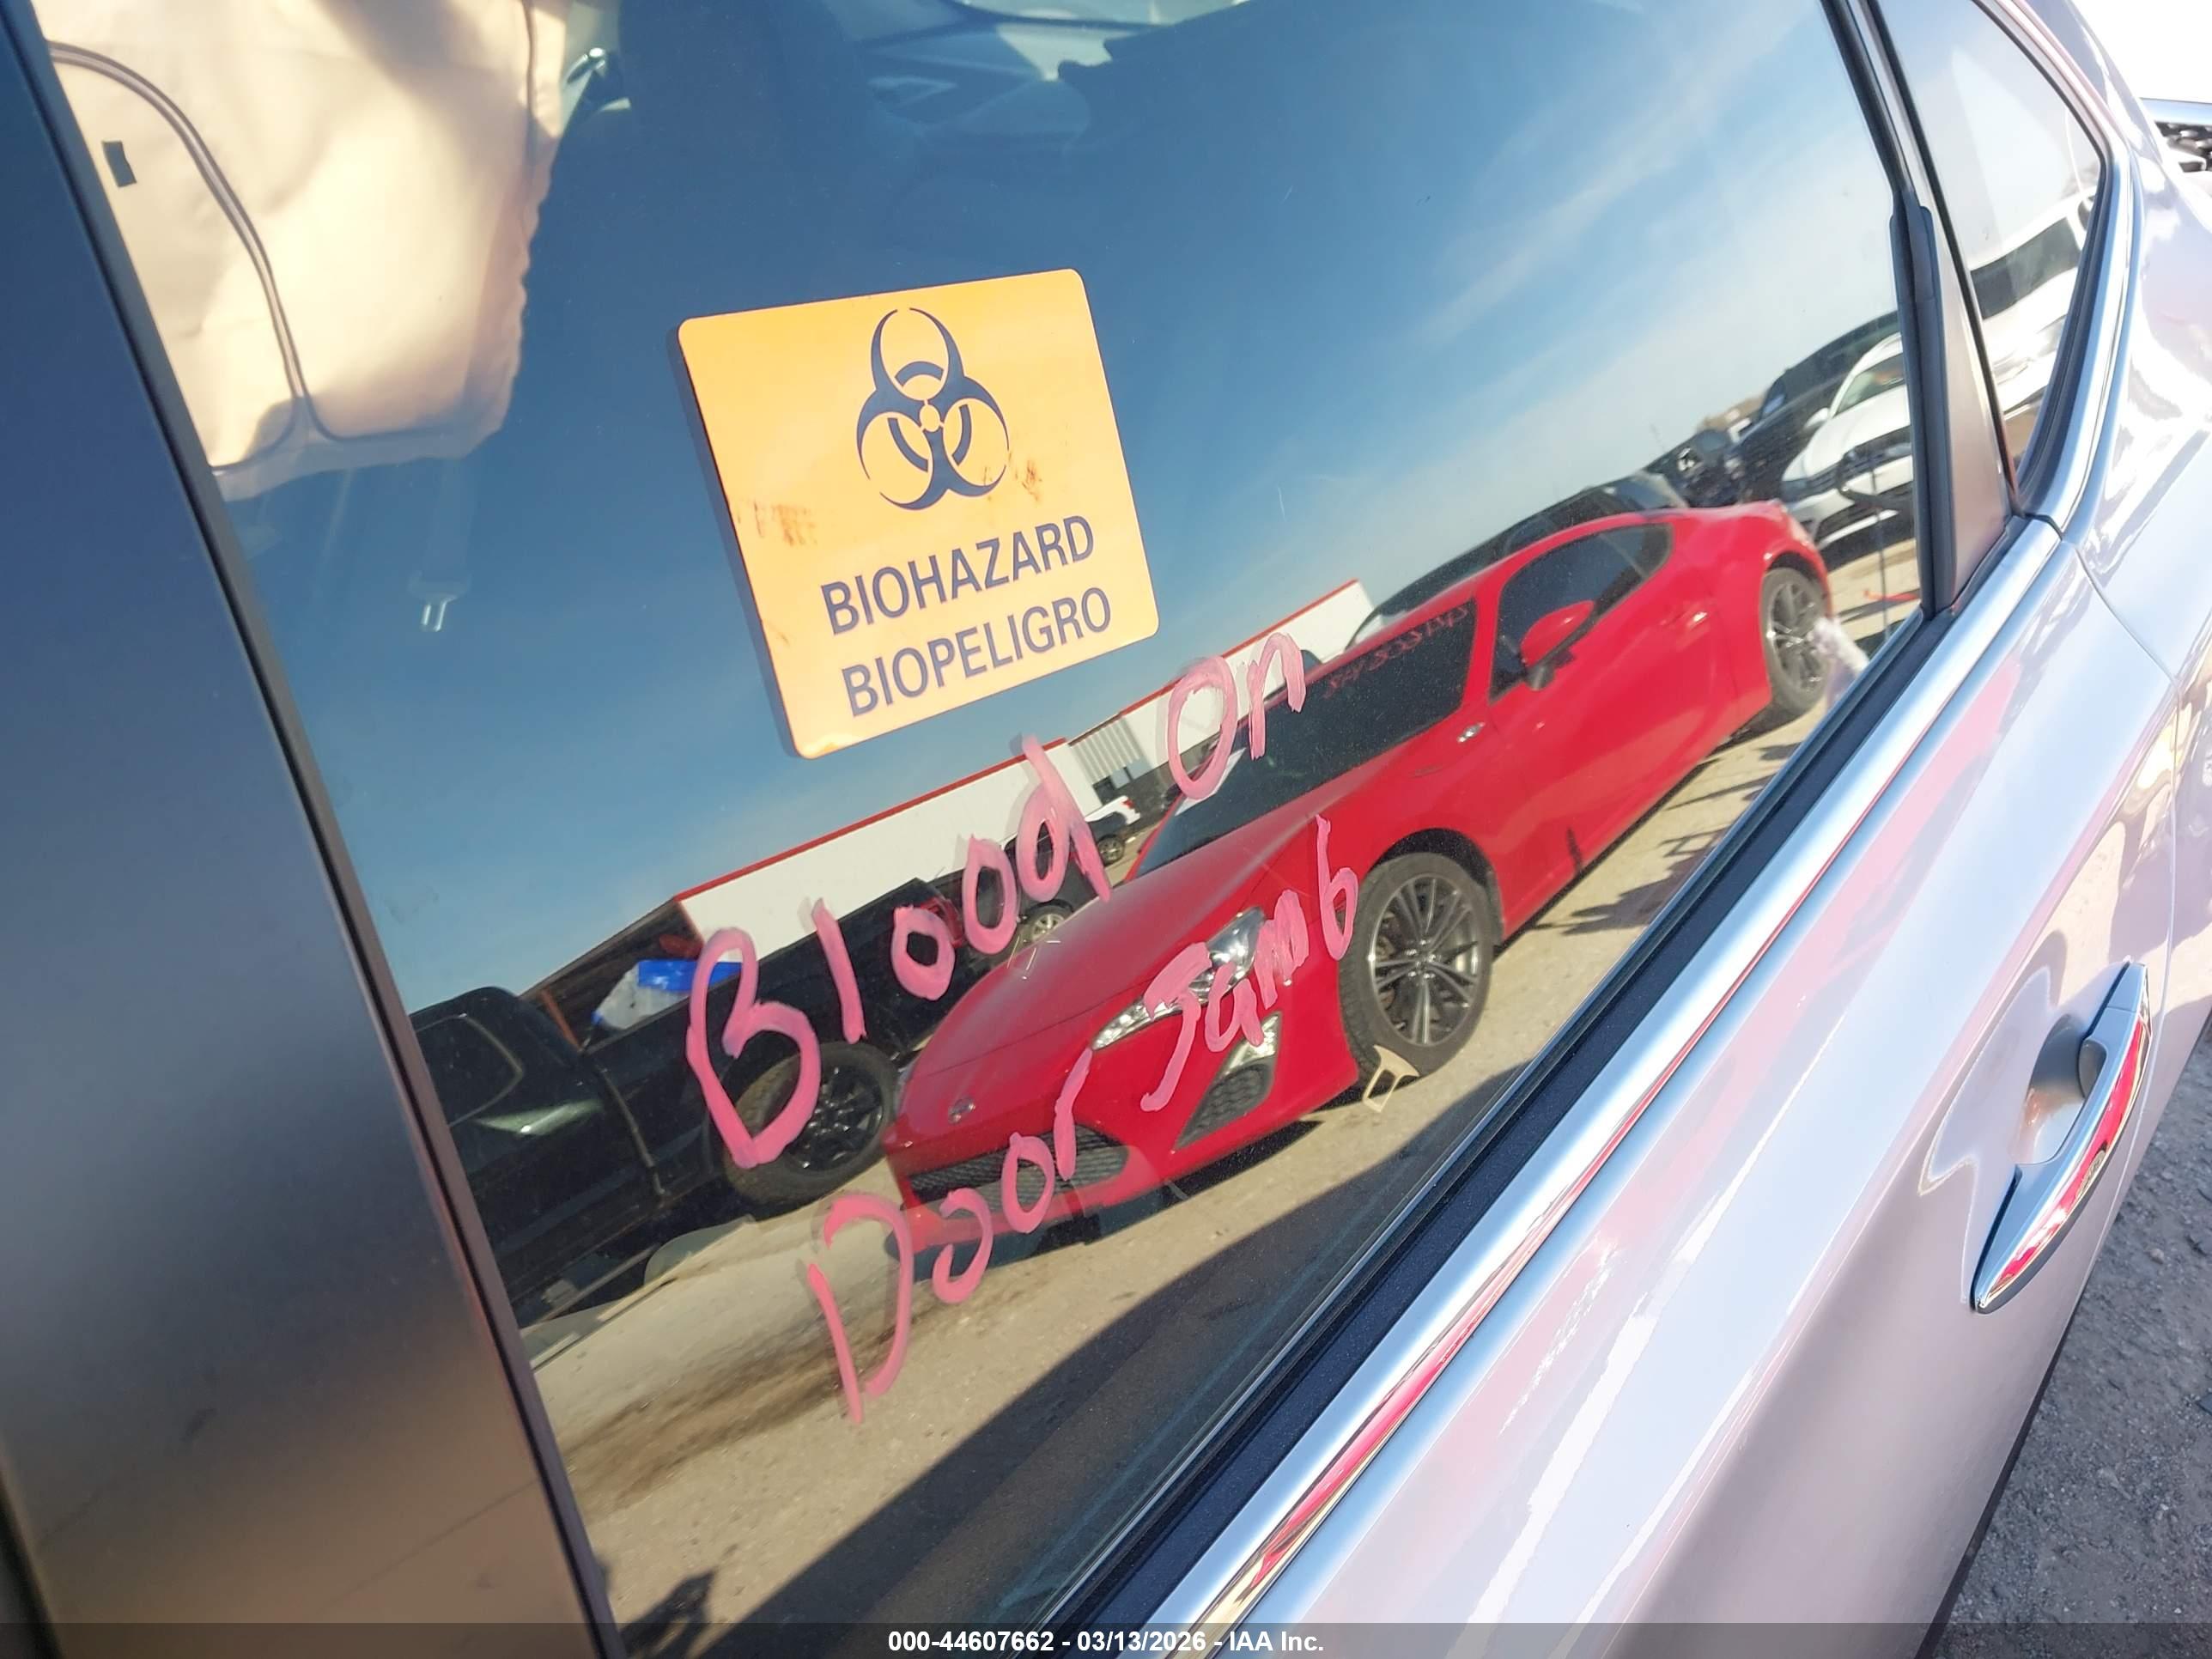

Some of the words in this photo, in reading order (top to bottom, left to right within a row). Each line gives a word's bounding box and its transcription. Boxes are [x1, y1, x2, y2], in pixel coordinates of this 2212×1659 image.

[820, 514, 1094, 636] BIOHAZARD
[842, 586, 1111, 718] BIOPELIGRO
[686, 735, 1111, 1170] Blood
[807, 1048, 1093, 1423] Door
[1139, 814, 1359, 1112] Jamb
